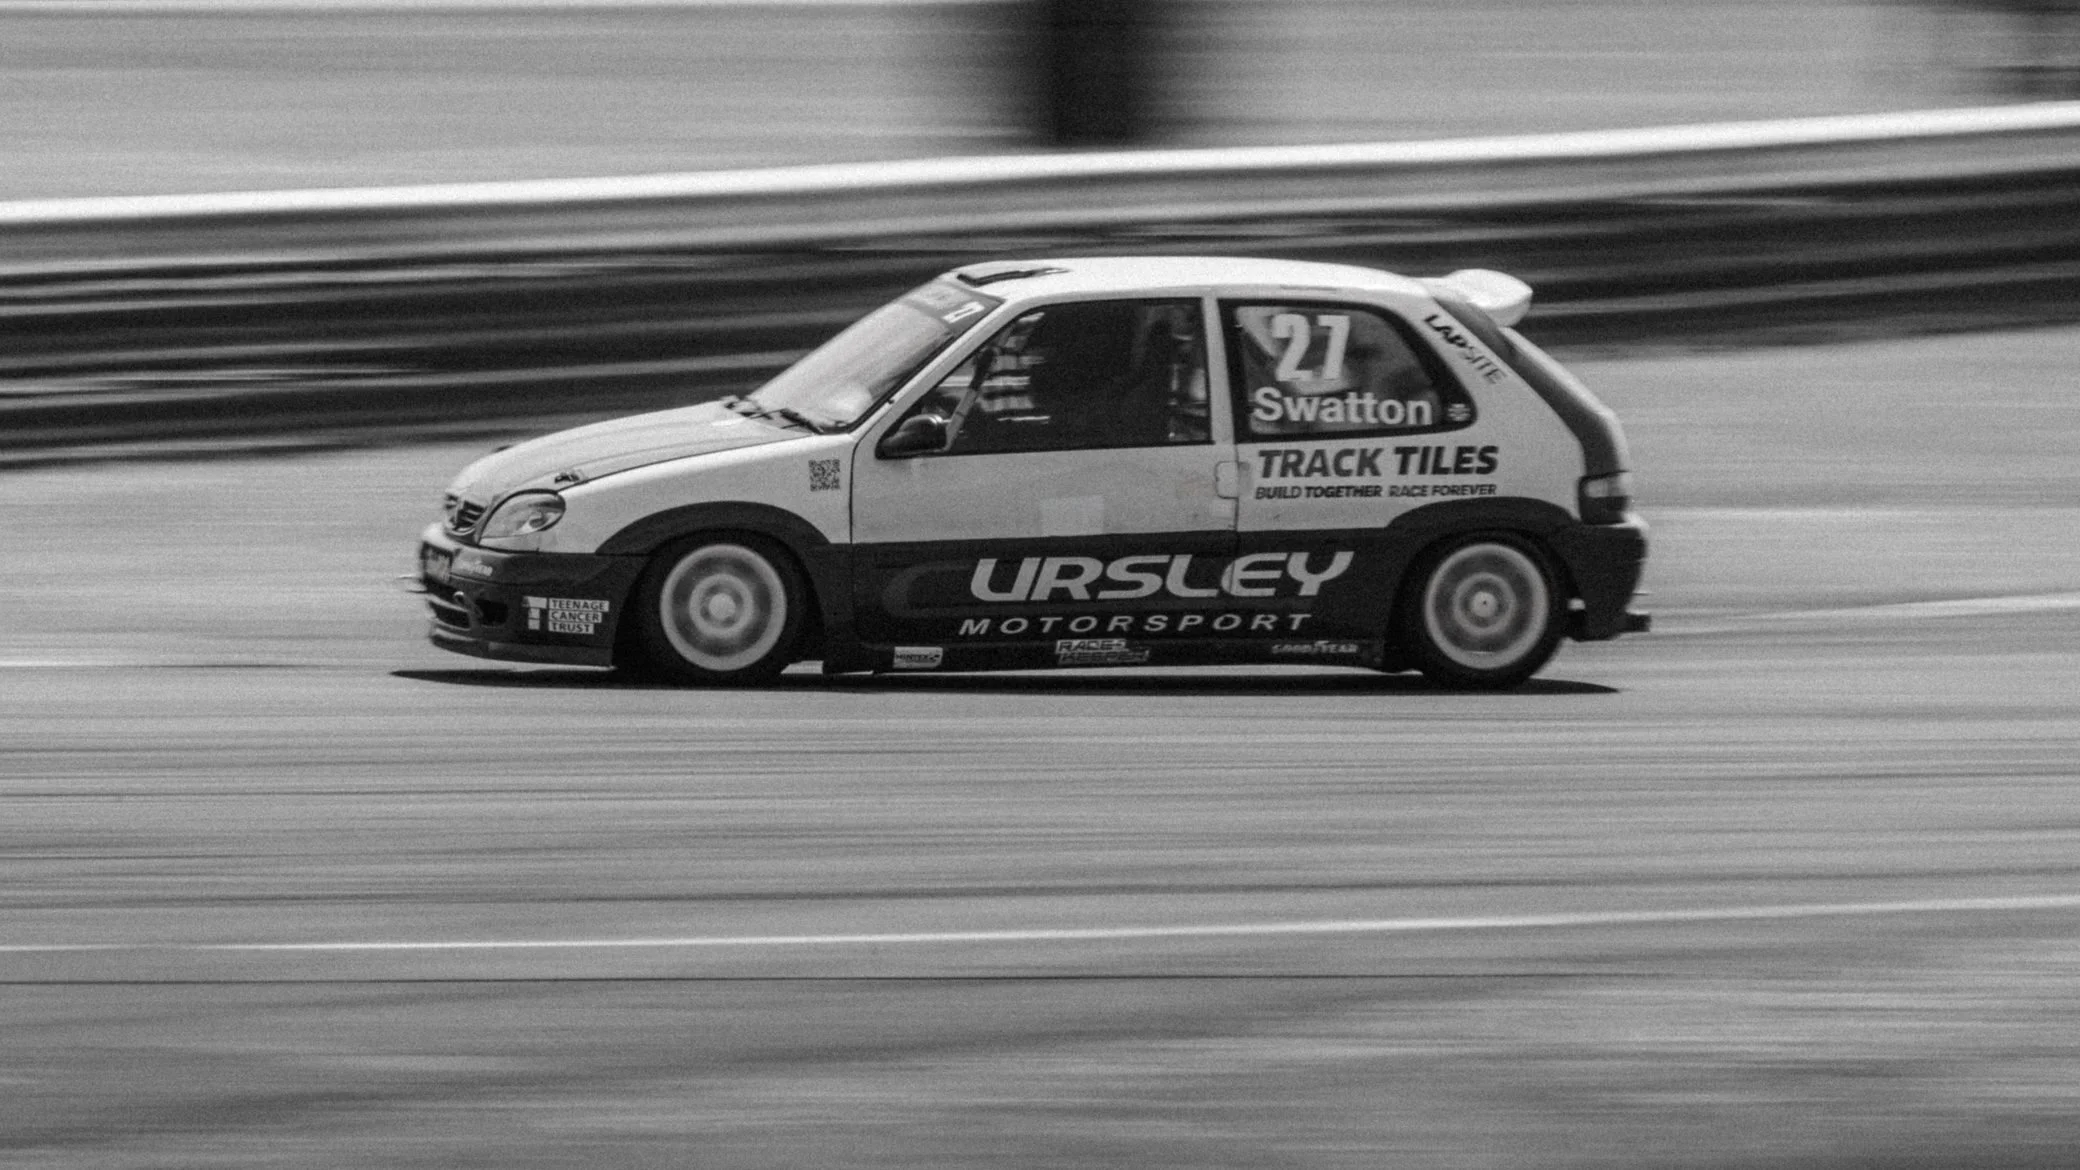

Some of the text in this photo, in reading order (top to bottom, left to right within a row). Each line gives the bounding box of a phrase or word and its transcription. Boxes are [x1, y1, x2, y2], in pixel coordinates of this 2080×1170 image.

[1271, 313, 1350, 382] 27
[1253, 386, 1433, 426] Swatton
[1258, 446, 1499, 479] TRACK TILES
[1255, 483, 1497, 500] BUILD TOGETHER RACE FOREVER
[970, 551, 1355, 602] URSLEY
[552, 600, 606, 611] TEENAGE
[551, 612, 600, 622] CANCER
[551, 623, 592, 633] TRUST
[958, 614, 1312, 636] MOTORSPORT
